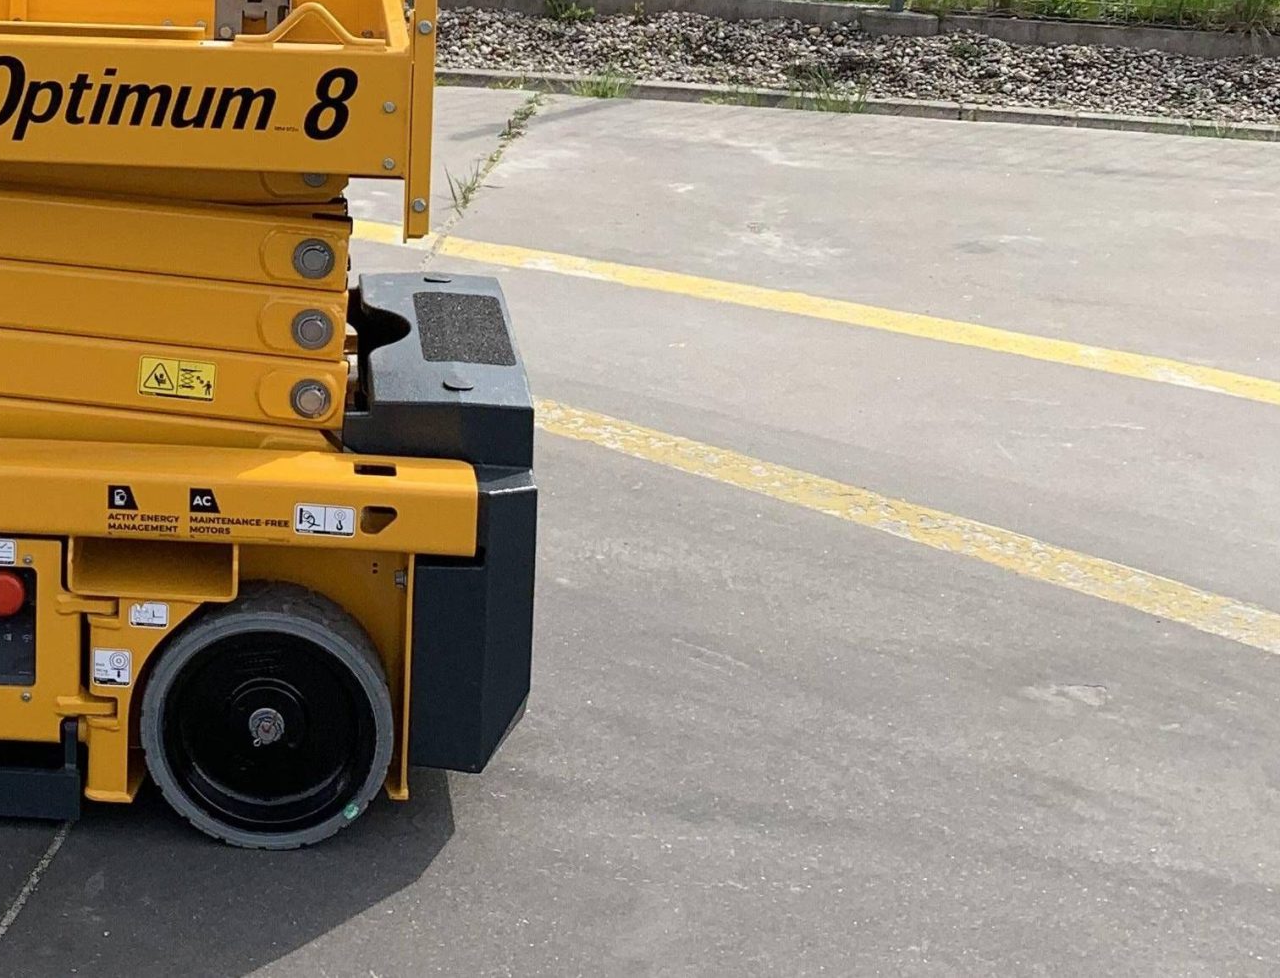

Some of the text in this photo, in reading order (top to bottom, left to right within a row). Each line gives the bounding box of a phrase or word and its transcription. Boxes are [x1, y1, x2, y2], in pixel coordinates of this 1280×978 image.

[304, 67, 359, 140] 8
[193, 495, 212, 507] AC
[140, 514, 179, 523] ENERGY
[108, 524, 178, 532] MANAGEMENT
[190, 526, 230, 534] MOTORS
